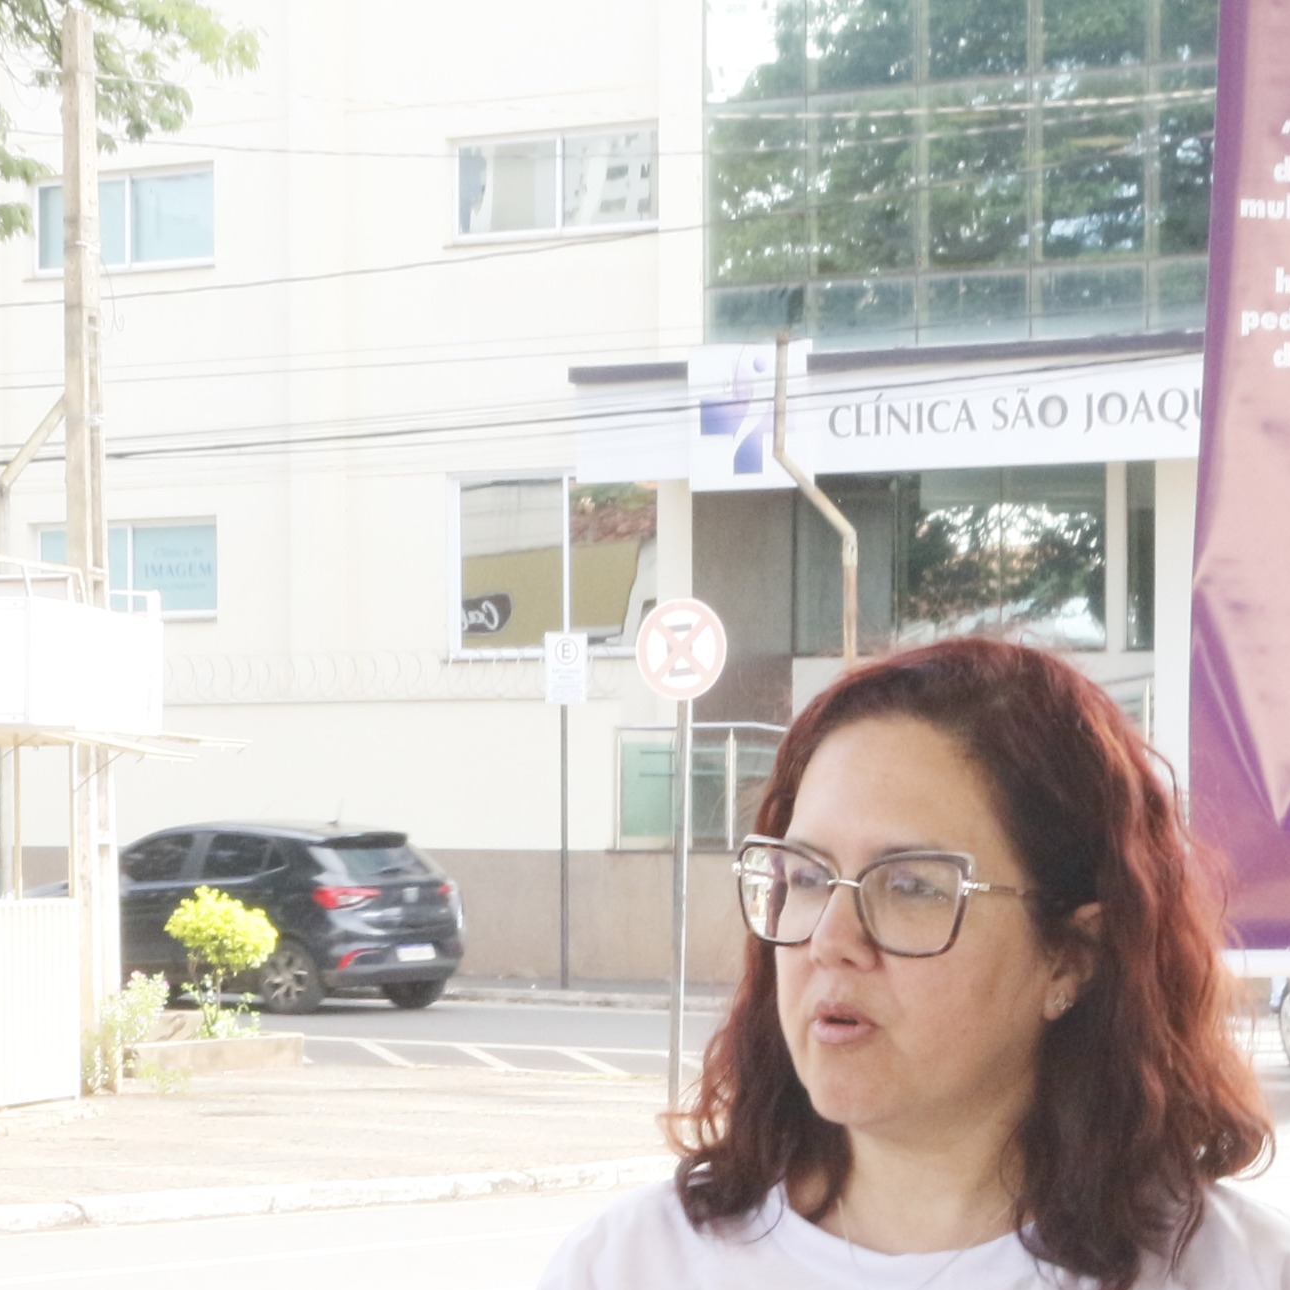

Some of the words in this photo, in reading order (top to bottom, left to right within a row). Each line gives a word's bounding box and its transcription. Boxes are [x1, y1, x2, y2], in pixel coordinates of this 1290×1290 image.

[828, 391, 977, 438] CLÍNICA
[992, 387, 1069, 429] SÃO
[145, 562, 211, 579] IMAGEM
[561, 642, 571, 660] E
